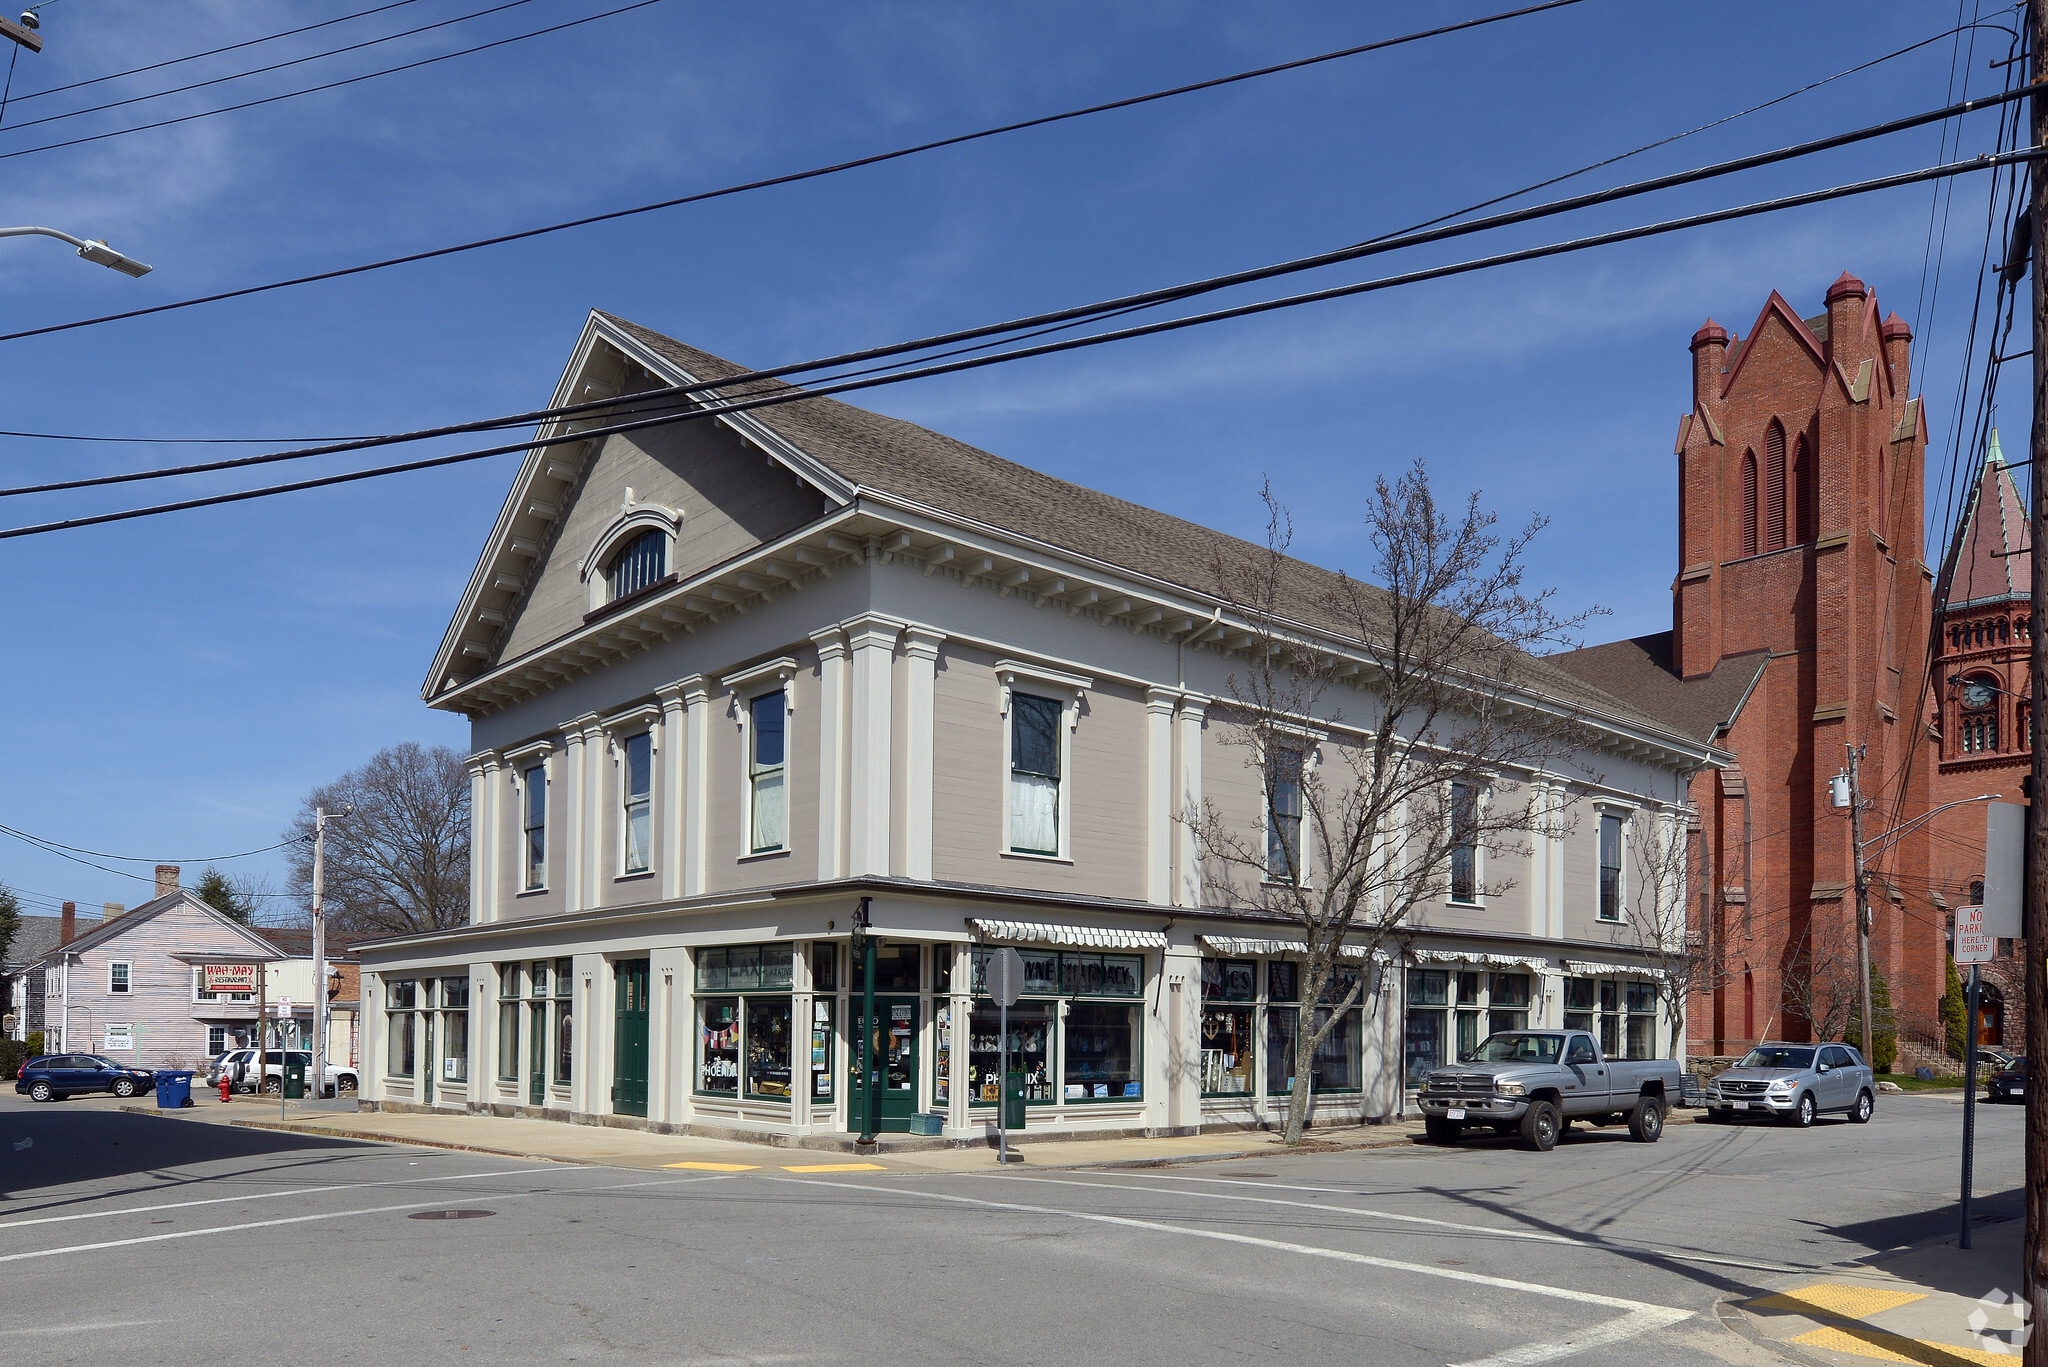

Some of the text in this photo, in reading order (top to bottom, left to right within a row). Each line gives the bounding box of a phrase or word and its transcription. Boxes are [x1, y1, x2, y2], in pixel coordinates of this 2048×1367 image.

[1970, 911, 1983, 921] NO
[1959, 924, 1983, 934] PARKI
[1962, 936, 1979, 944] HERE
[1962, 944, 1988, 952] CORNER
[207, 966, 254, 975] WAH-MAY
